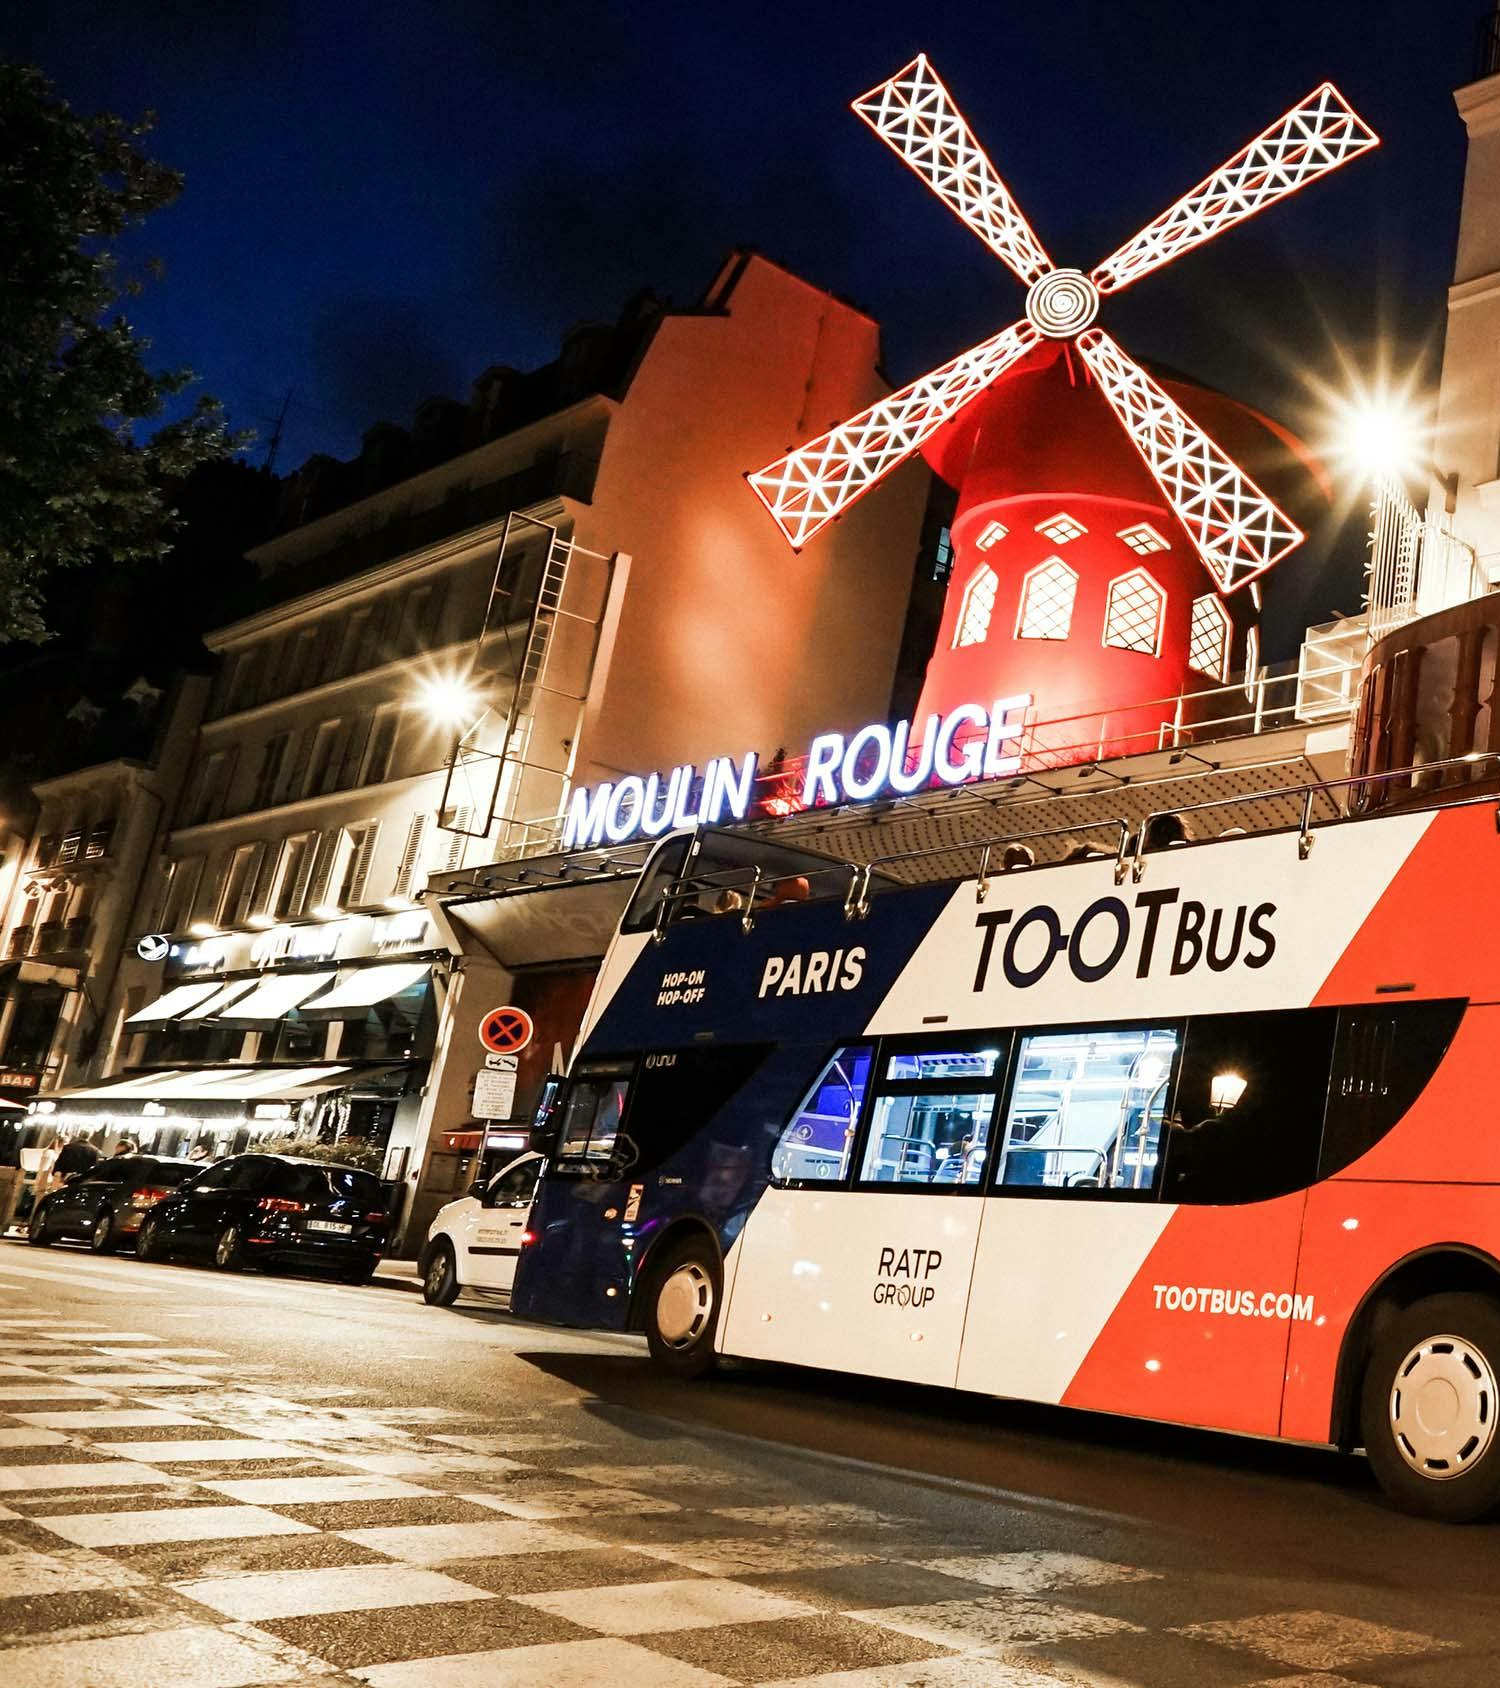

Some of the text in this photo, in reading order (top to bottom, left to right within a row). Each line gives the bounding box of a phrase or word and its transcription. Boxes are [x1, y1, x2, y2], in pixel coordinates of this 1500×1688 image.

[564, 694, 1035, 848] MOULIN ROUGE
[661, 970, 705, 988] HOP-ON
[758, 946, 866, 998] PARIS
[656, 988, 705, 1006] HOP-OFF
[1, 1074, 33, 1087] BAR
[878, 1247, 942, 1279] RATP
[873, 1283, 935, 1309] GROUP
[1153, 1284, 1315, 1321] TOOTBUS.COM
